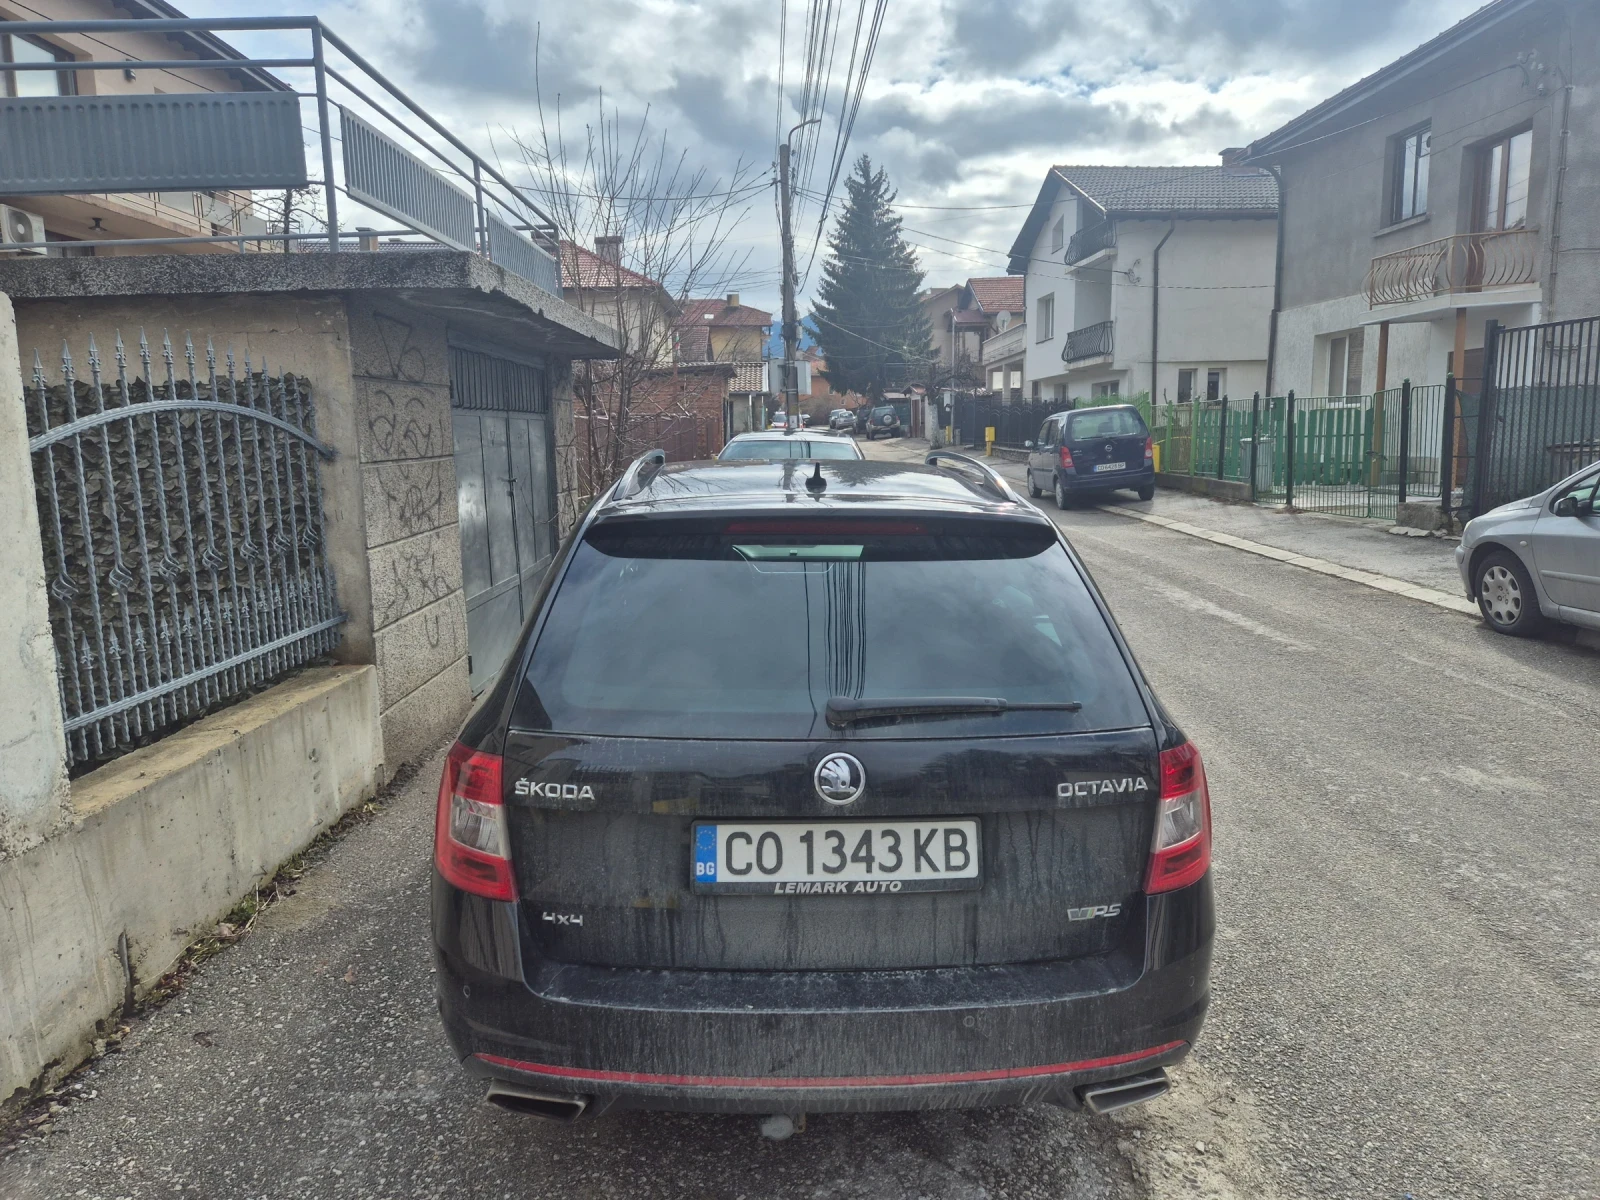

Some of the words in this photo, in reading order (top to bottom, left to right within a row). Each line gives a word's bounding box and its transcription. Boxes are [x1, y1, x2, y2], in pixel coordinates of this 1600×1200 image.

[514, 777, 596, 801] ŠKODA
[1057, 777, 1149, 797] OCTAVIA
[725, 831, 783, 876] CO
[799, 829, 904, 875] 1343
[913, 828, 971, 873] KB
[696, 861, 715, 876] BG
[773, 881, 849, 895] LEMARK
[853, 880, 902, 893] AUTO
[541, 911, 584, 927] 4x4
